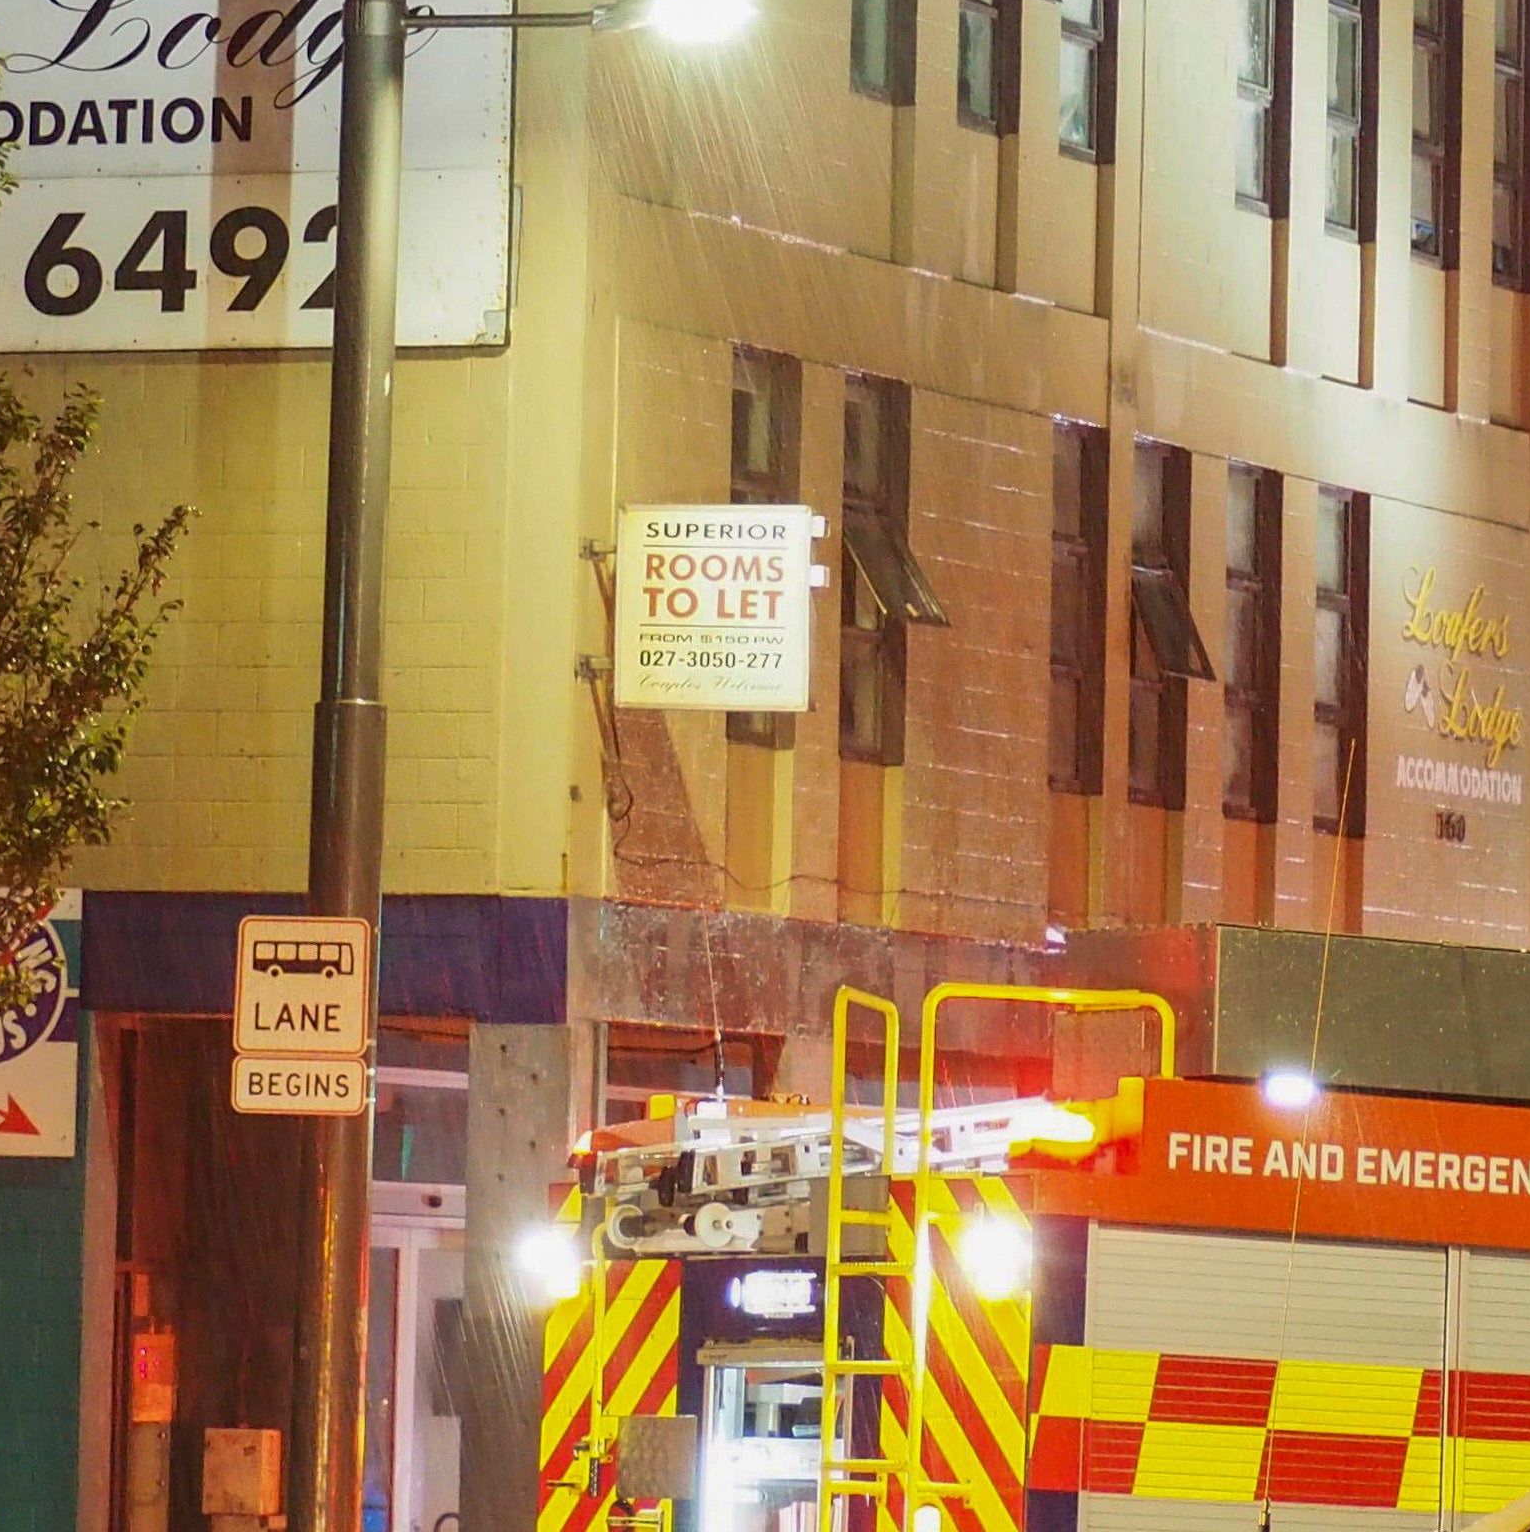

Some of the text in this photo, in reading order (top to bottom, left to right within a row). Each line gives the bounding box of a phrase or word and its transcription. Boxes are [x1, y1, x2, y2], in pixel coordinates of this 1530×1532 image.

[646, 521, 786, 541] SUPERIOR
[645, 553, 784, 582] ROOMS
[642, 587, 784, 620] TO LET
[1401, 566, 1510, 662] Loafers
[639, 633, 693, 643] FROM
[639, 650, 783, 669] 027-3050-277
[1439, 664, 1525, 768] Lodge
[1395, 755, 1523, 806] ACCOMMODATION
[254, 1002, 341, 1032] LANE
[248, 1072, 350, 1098] BEGINS
[1168, 1132, 1254, 1174] FIRE
[1263, 1140, 1344, 1181] AND
